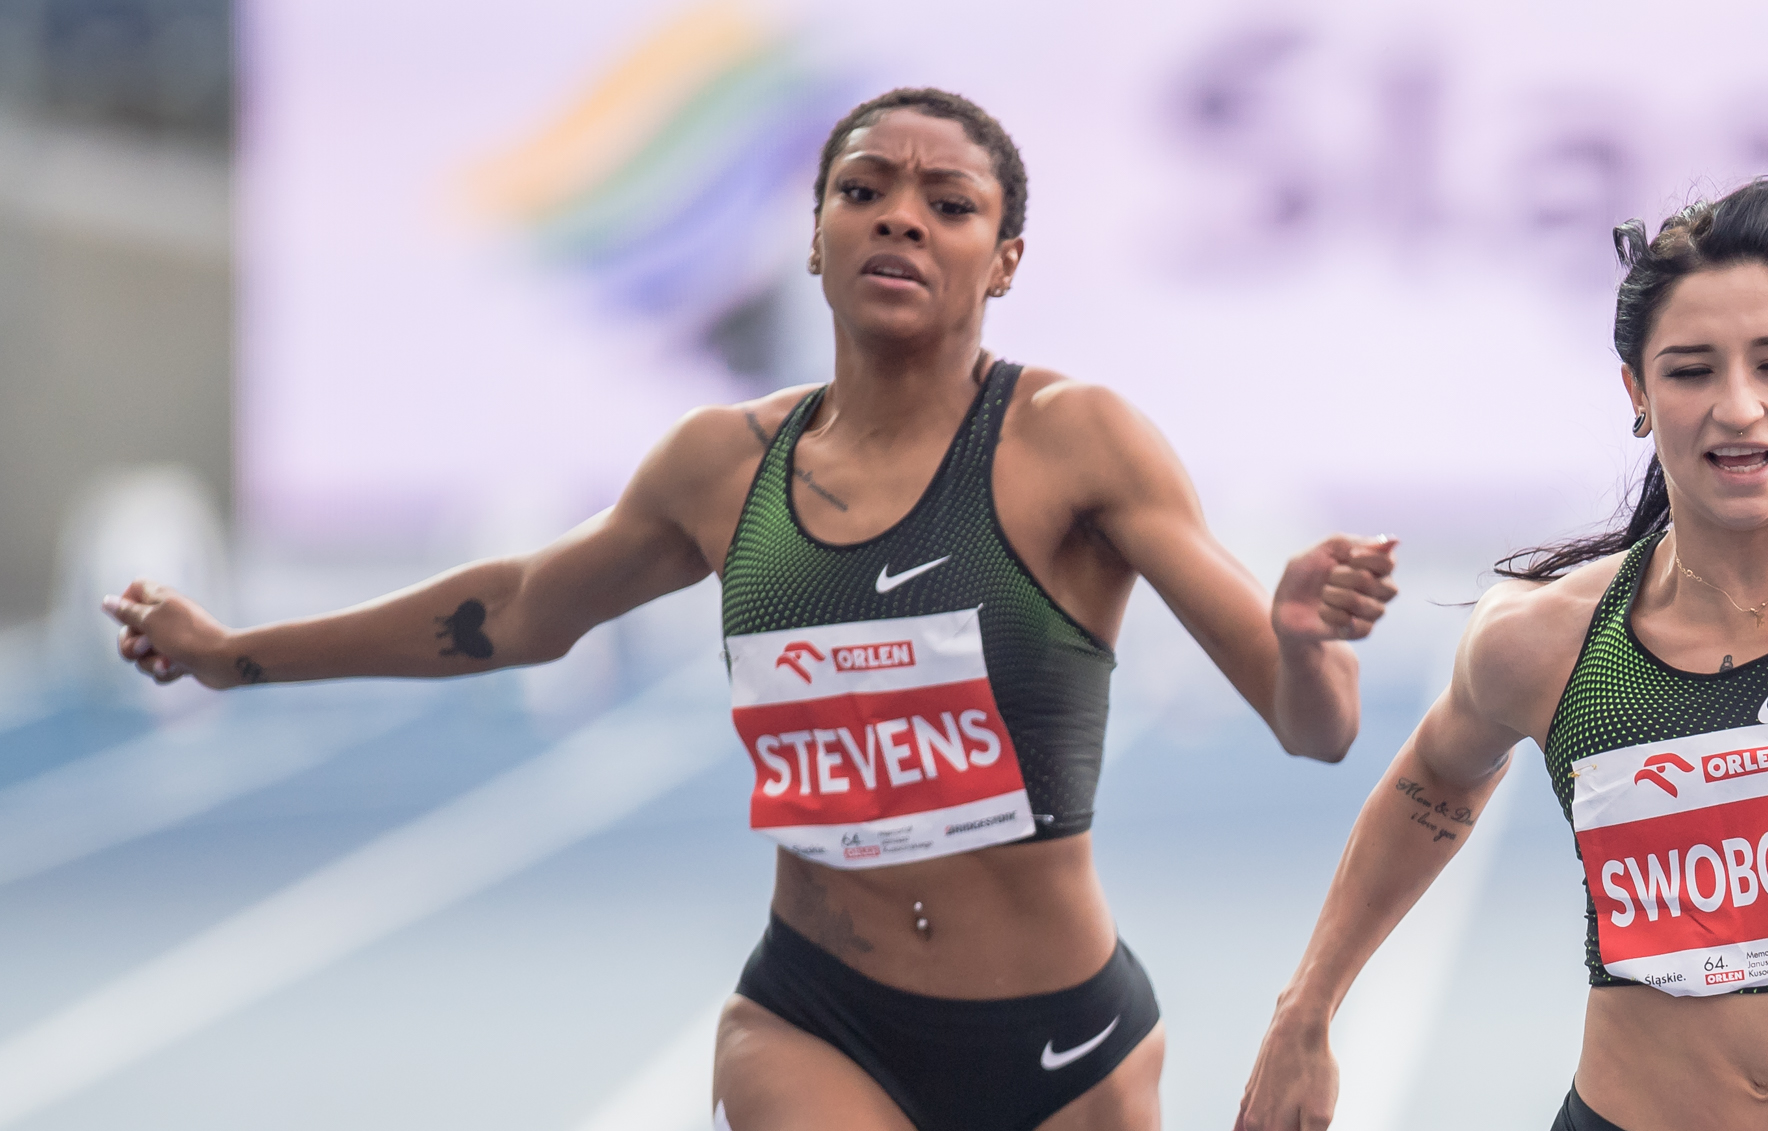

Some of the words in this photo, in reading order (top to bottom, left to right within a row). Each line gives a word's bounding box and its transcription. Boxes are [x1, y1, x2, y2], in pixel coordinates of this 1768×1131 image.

[837, 644, 910, 669] ORLEN
[755, 708, 1002, 798] STEVENS
[1434, 801, 1450, 817] &
[1707, 970, 1743, 984] ORLEN
